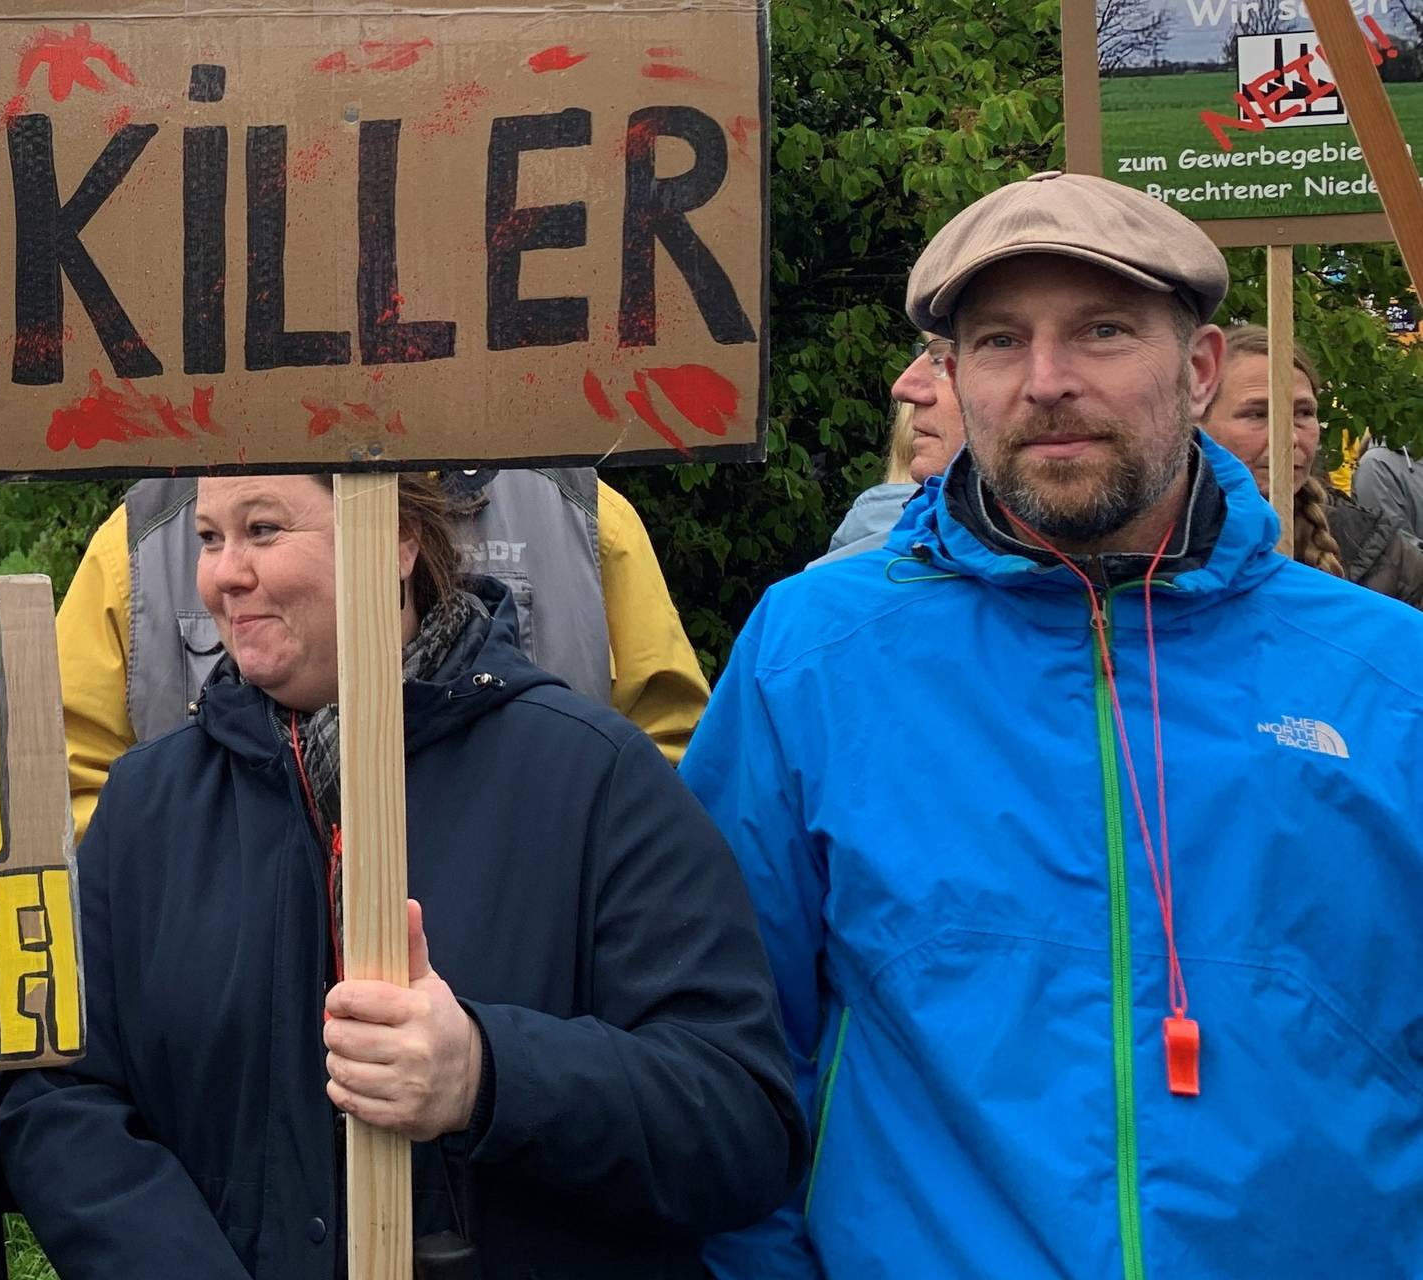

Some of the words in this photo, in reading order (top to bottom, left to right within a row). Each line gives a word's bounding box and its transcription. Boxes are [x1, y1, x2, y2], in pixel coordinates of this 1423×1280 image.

[1187, 0, 1259, 27] Wir
[1118, 154, 1167, 173] zum
[1178, 141, 1363, 170] Gewerbegebie
[1146, 180, 1292, 202] Brechtener
[1305, 173, 1377, 197] Niede
[462, 540, 527, 562] NDT
[1257, 722, 1318, 741] NORTH
[1281, 714, 1316, 730] THE
[1276, 734, 1320, 752] FACE
